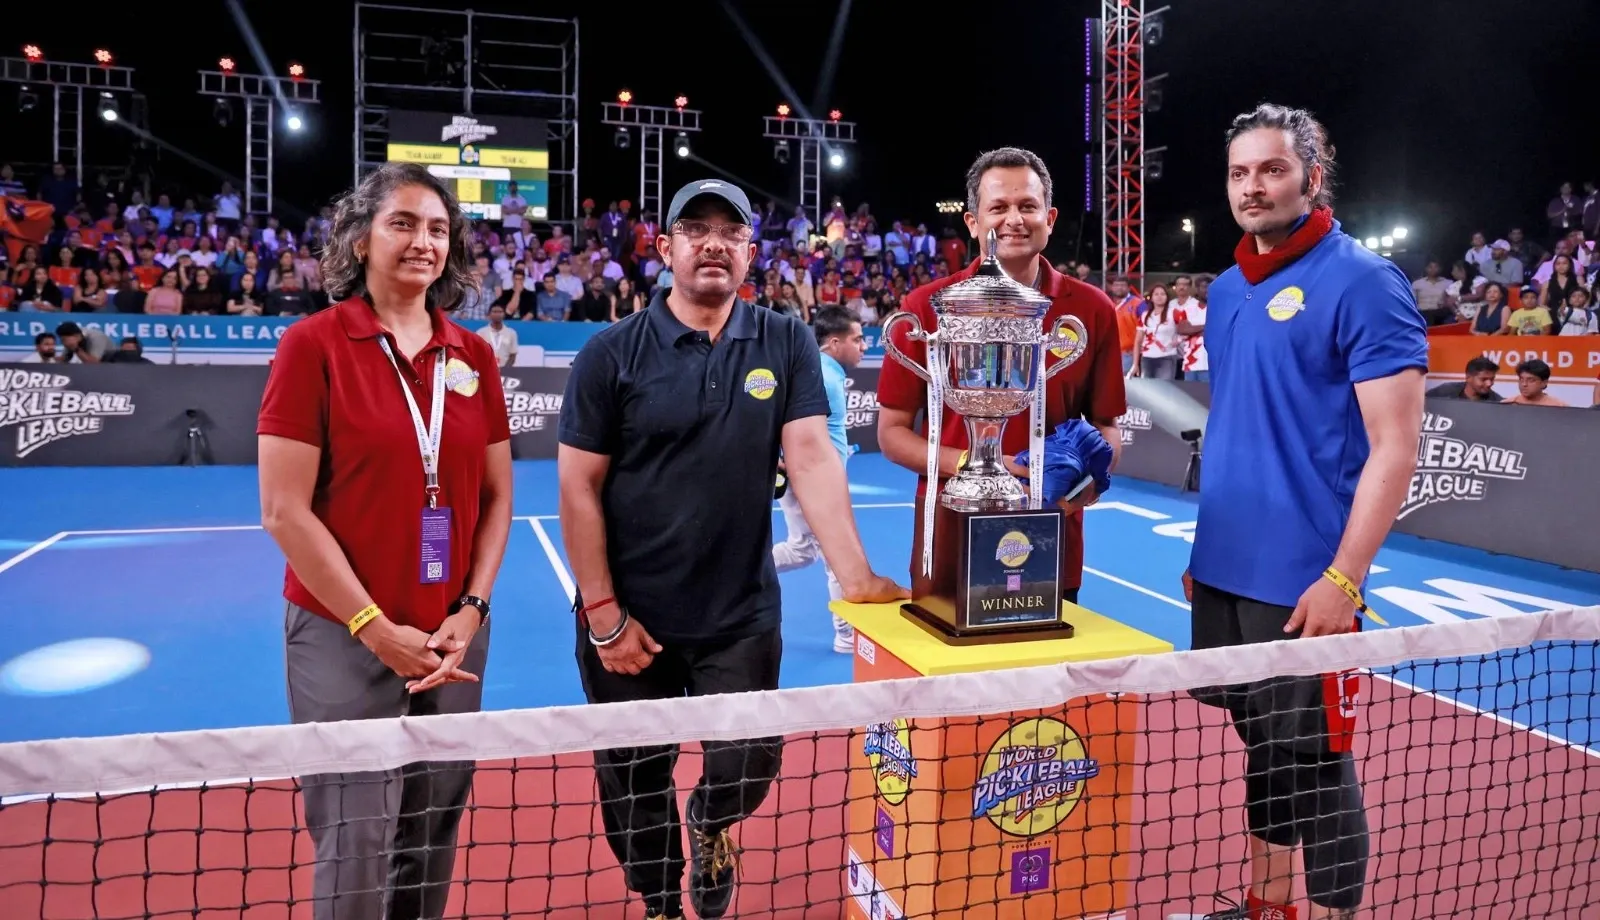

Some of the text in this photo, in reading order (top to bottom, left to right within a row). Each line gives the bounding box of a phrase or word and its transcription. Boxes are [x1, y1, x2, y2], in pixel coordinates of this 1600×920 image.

[508, 415, 545, 431] GUE
[845, 411, 873, 426] GUE
[17, 417, 101, 451] LEAGUE
[1417, 438, 1522, 474] EBALL
[1399, 474, 1485, 509] EAGUE
[981, 595, 1044, 611] WINNER
[1000, 746, 1056, 767] WORLD
[974, 760, 1098, 811] PICKLEBALL
[1016, 780, 1077, 817] LEAGUE
[1021, 874, 1039, 884] PNG
